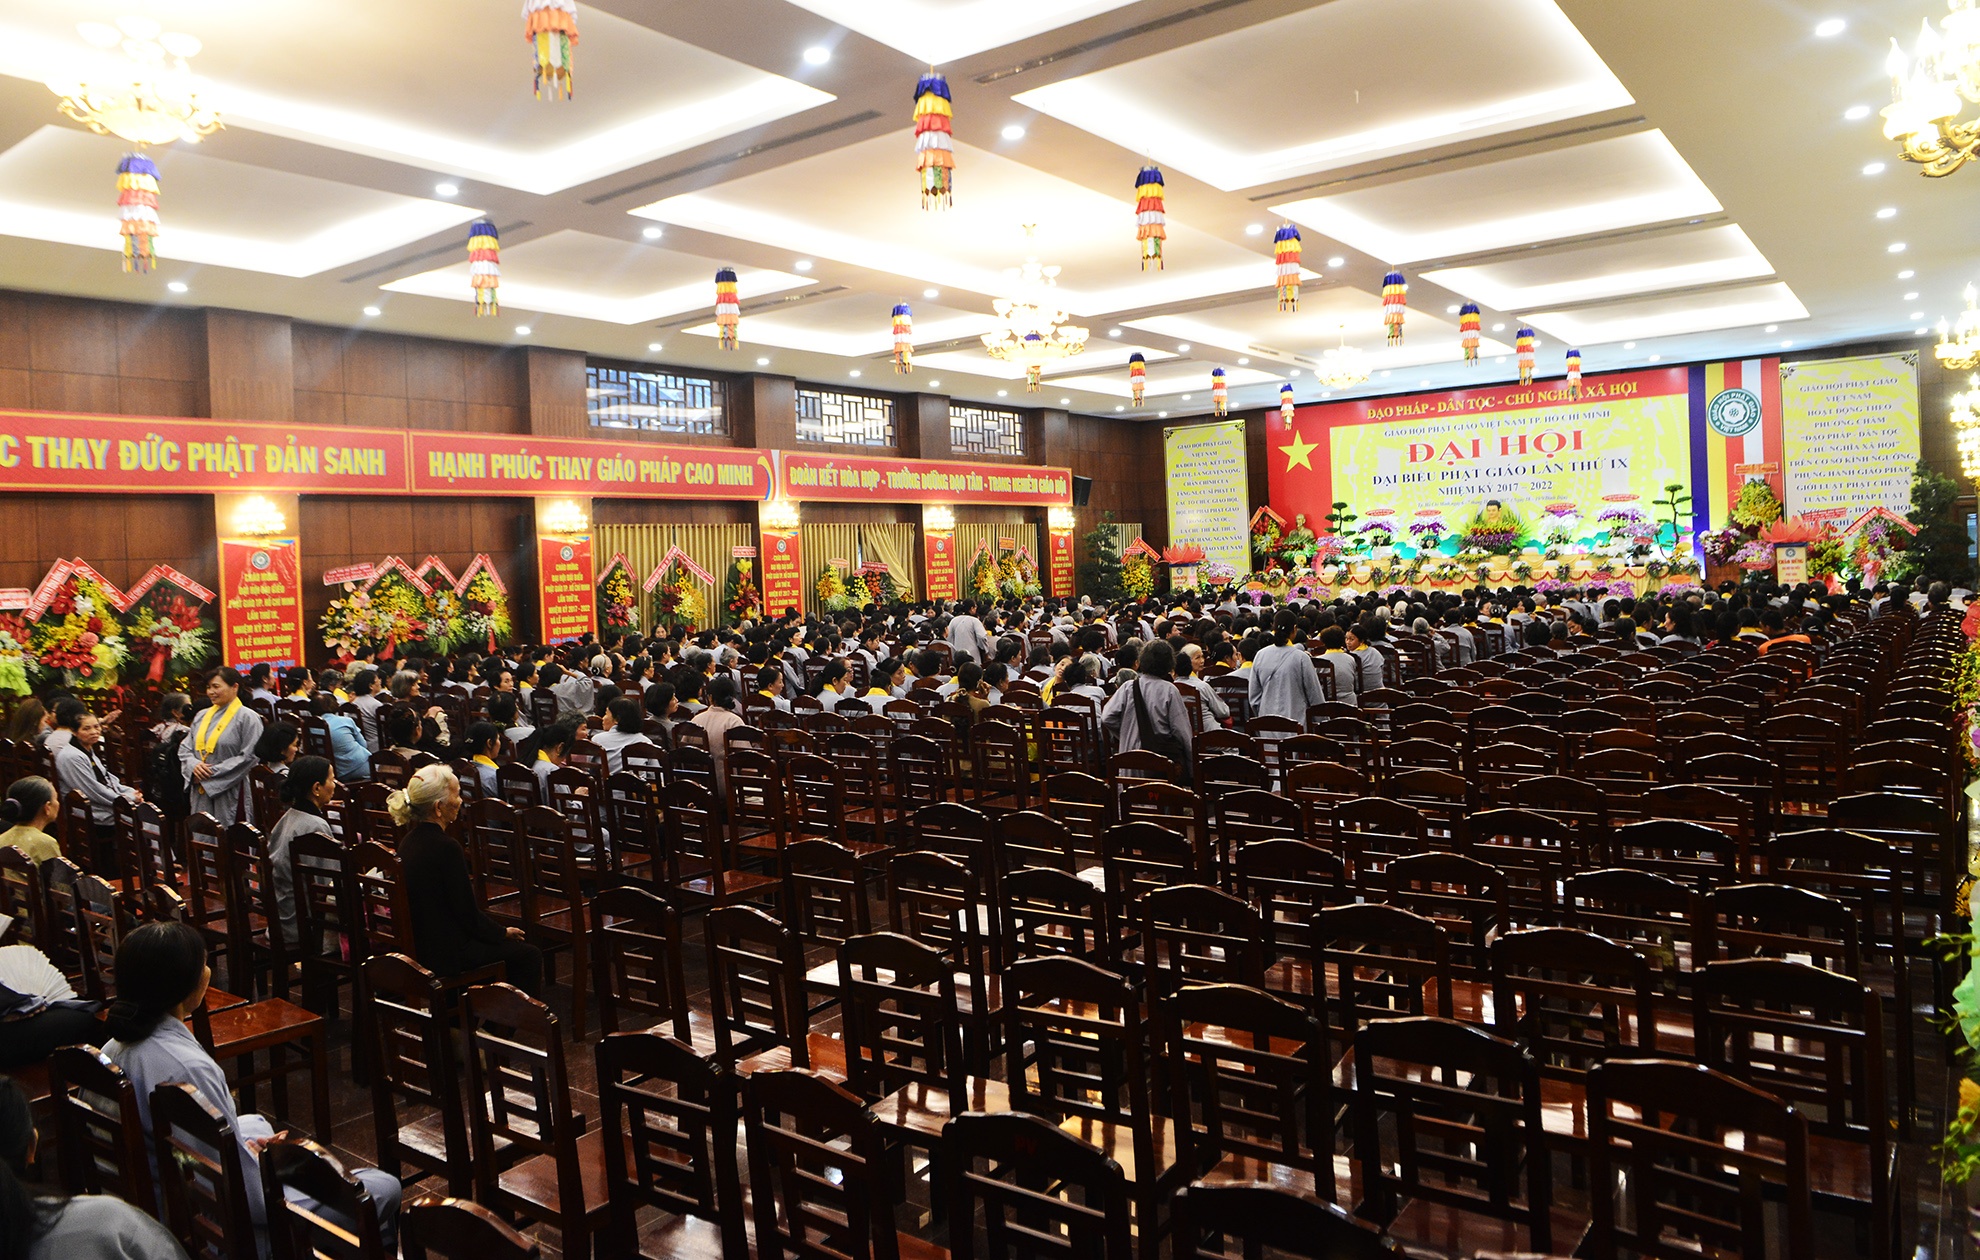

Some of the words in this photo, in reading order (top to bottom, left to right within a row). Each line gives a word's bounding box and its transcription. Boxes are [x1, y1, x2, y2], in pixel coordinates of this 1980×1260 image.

[1366, 406, 1394, 420] ĐẠO
[1396, 401, 1429, 416] PHÁP
[1438, 398, 1464, 412] DÂN
[1467, 396, 1496, 411] TỘC
[1505, 390, 1534, 406] CHỦ
[1586, 383, 1606, 398] XÃ
[1610, 382, 1638, 397] HỘI
[1848, 392, 1872, 401] NAM
[1866, 404, 1892, 412] THEO
[1454, 422, 1478, 431] GIÁO
[1504, 418, 1526, 426] NAM
[1582, 410, 1611, 420] MINH
[25, 435, 110, 470] THAY
[118, 433, 181, 472] ĐỨC
[187, 436, 258, 478] PHẬT
[265, 434, 318, 474] ĐẢN
[324, 446, 387, 476] SANH
[1406, 438, 1482, 466] ĐẠI
[1500, 428, 1584, 458] HỘI
[428, 450, 486, 484] HẠNH
[490, 448, 543, 480] PHÚC
[546, 456, 593, 481] THAY
[597, 452, 636, 483] GIÁO
[640, 456, 682, 485] PHÁP
[685, 462, 714, 485] CAO
[718, 464, 754, 486] MINH
[790, 462, 818, 486] ĐOÀN
[819, 462, 838, 487] KẾT
[840, 464, 860, 488] HÒA
[860, 468, 880, 492] HỢP
[1373, 474, 1398, 486] ĐẠI
[1441, 468, 1482, 482] PHẬT
[1486, 464, 1526, 478] GIÁO
[1568, 457, 1606, 472] THỨ
[1610, 458, 1629, 469] IX
[1438, 485, 1474, 496] NHIỆM
[1478, 482, 1494, 494] KỲ
[1498, 482, 1519, 493] 2017
[1530, 480, 1553, 491] 2022
